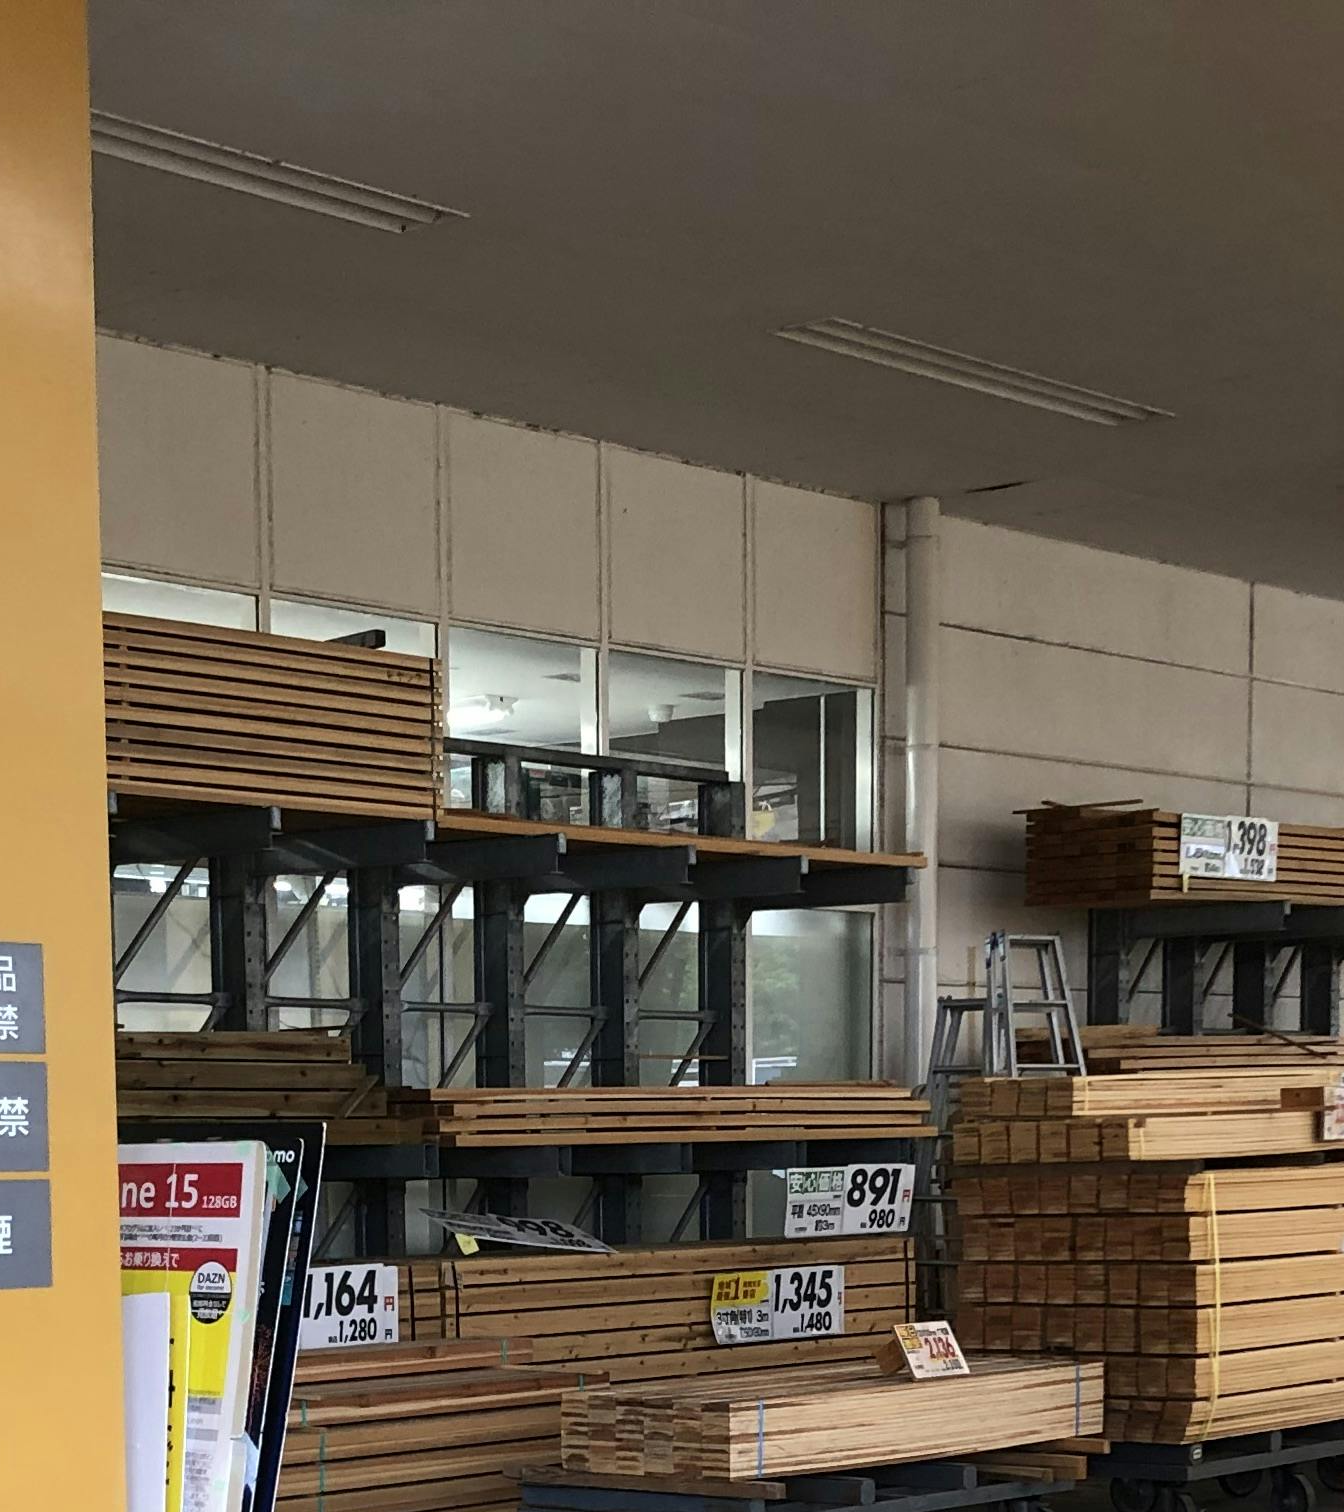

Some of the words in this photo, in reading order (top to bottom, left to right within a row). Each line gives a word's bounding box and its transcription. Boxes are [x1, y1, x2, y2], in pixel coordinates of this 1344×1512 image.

[164, 1173, 199, 1209] 15
[202, 1195, 237, 1209] 128GB
[847, 1168, 902, 1208] 891
[868, 1208, 895, 1229] 980
[197, 1272, 226, 1284] DAZN
[774, 1270, 834, 1314] 1,345
[303, 1269, 378, 1321] 1,164
[338, 1317, 377, 1344] 1,280
[799, 1310, 833, 1333] 1,480
